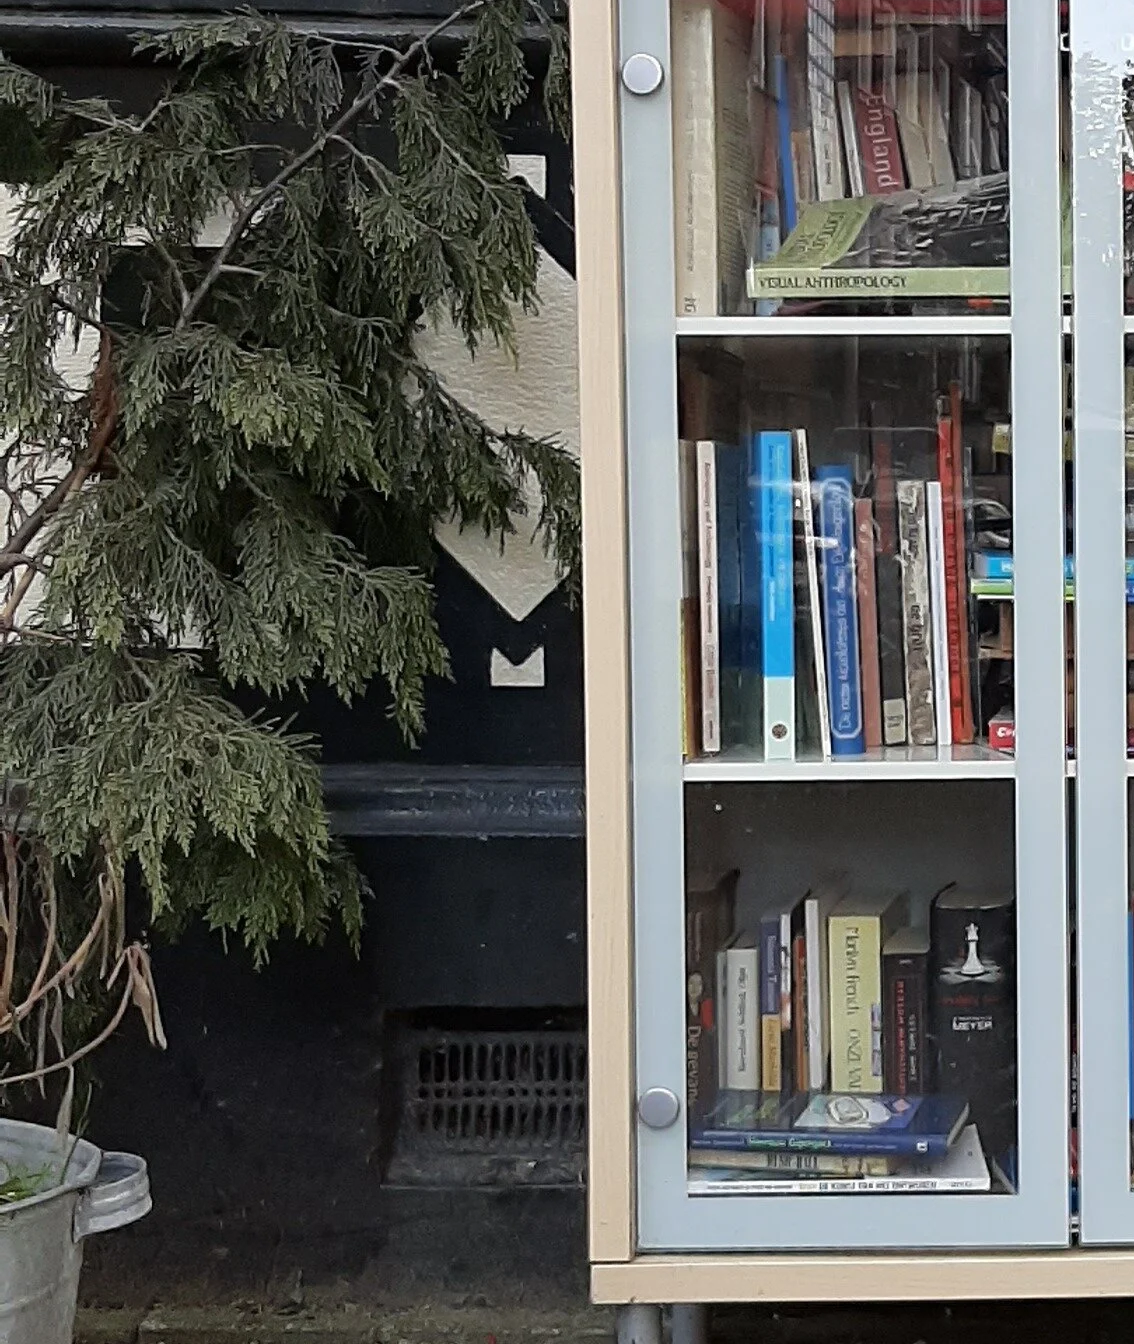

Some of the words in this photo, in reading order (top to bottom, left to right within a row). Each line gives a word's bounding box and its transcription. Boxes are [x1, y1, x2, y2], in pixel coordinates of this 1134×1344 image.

[864, 95, 899, 188] England
[759, 276, 802, 289] VISUAL
[805, 275, 908, 289] ANTHROPOLOGY
